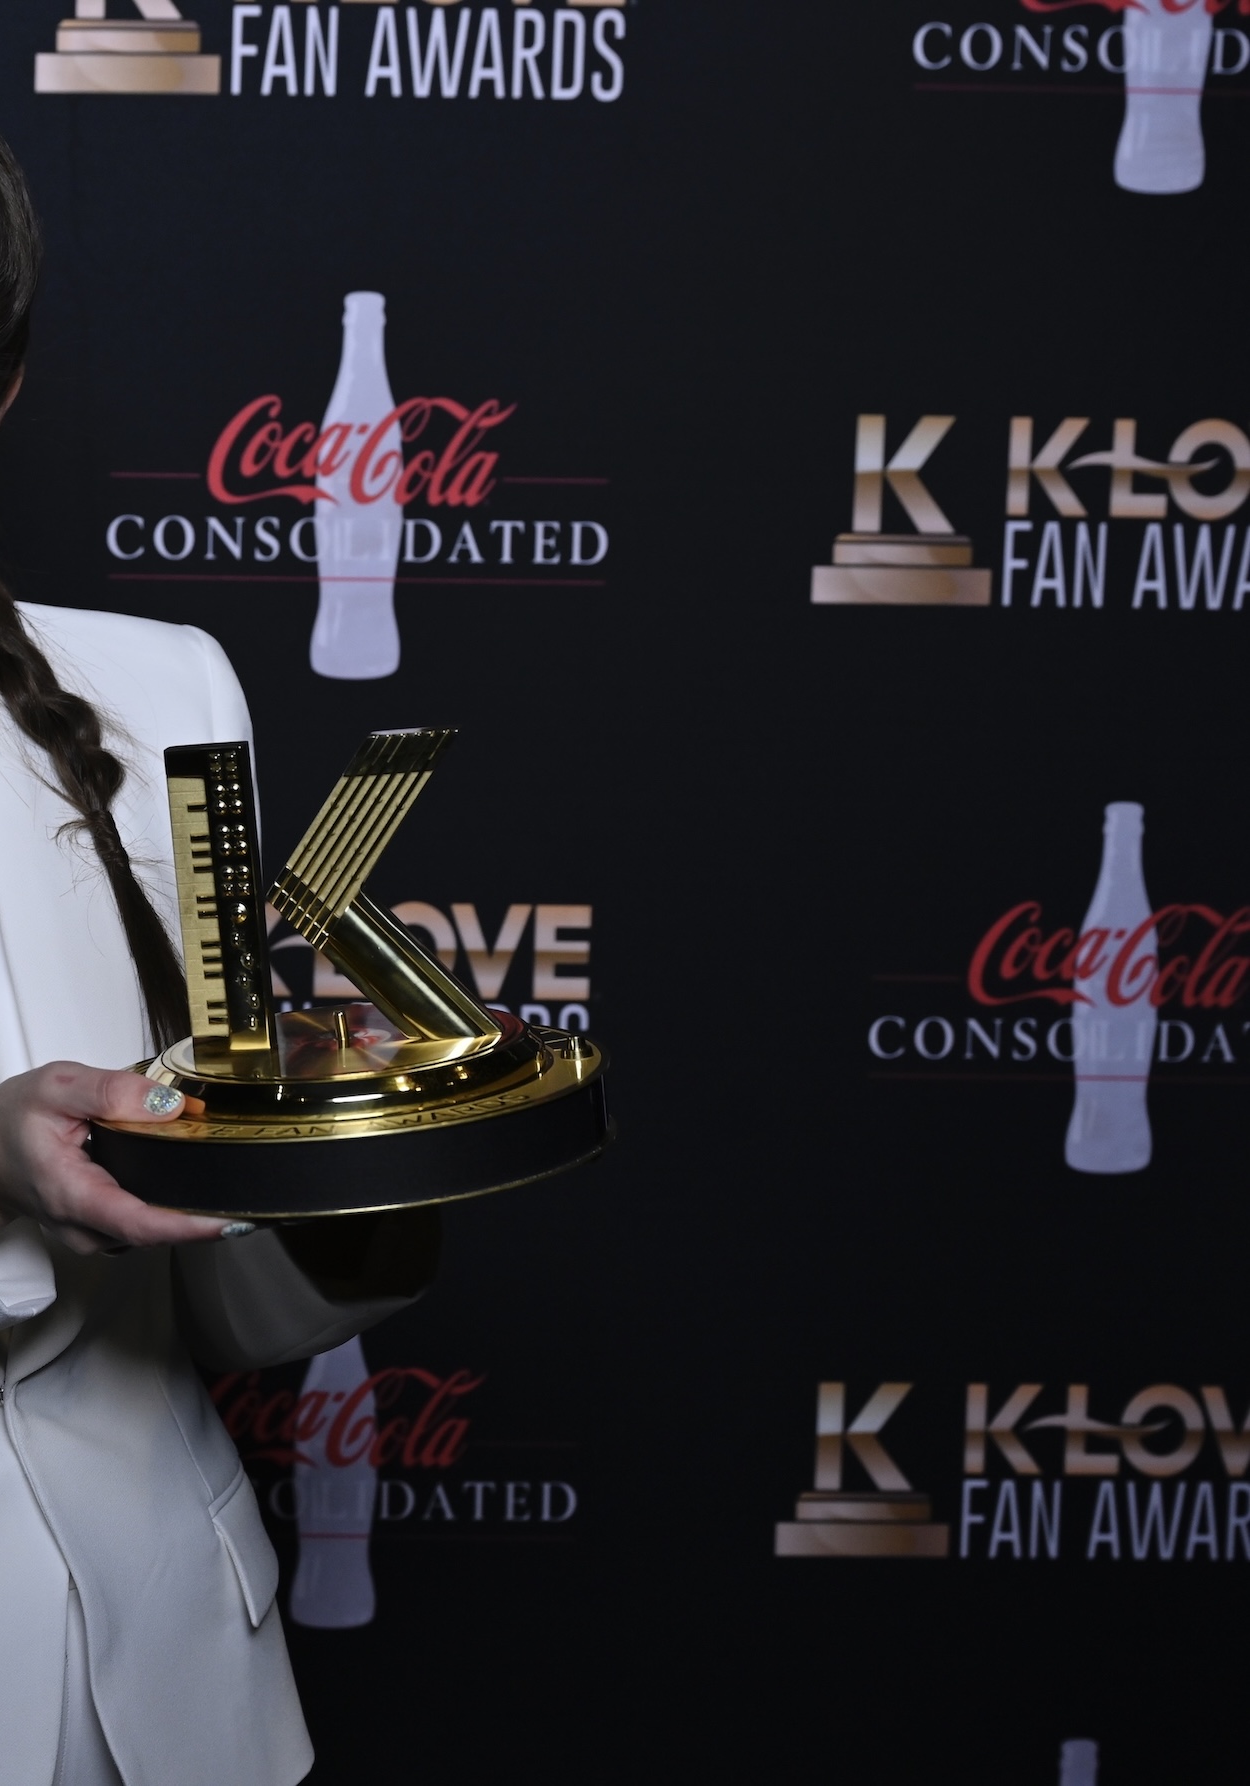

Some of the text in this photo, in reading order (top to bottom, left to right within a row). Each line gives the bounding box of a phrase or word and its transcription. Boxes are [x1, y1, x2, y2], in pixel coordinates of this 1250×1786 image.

[230, 4, 627, 102] FAN AWARDS
[206, 393, 518, 507] Coca-Cola
[1000, 519, 1109, 609] FAN
[966, 900, 1250, 1009] Coca-Cola
[958, 1478, 1063, 1560] FAN
